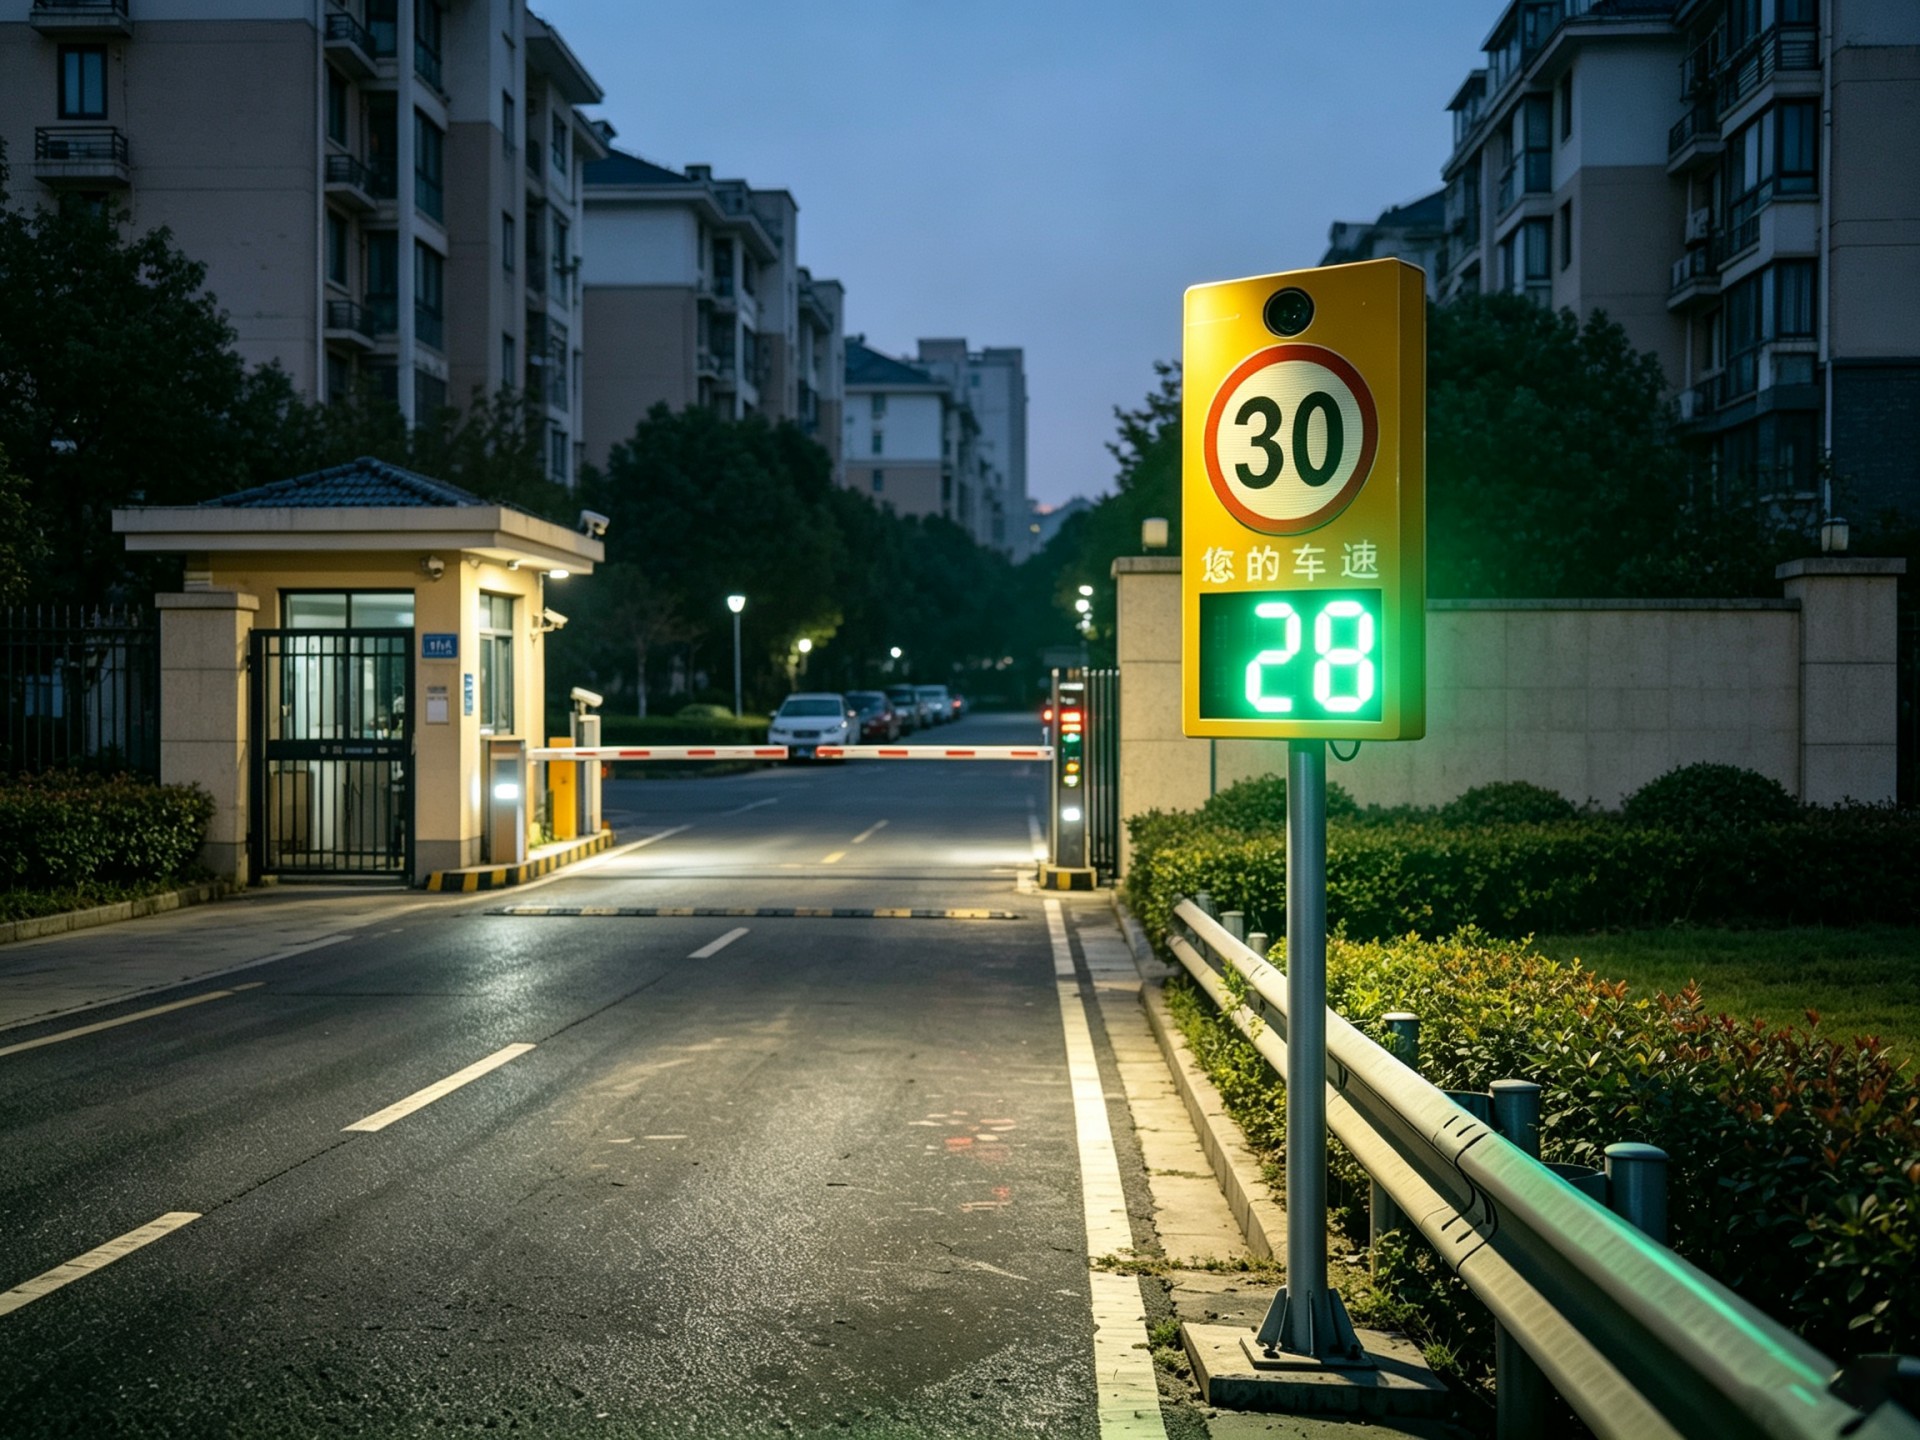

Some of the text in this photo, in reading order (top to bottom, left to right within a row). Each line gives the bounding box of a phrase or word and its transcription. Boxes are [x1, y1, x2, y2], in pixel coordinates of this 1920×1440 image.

[1235, 391, 1344, 489] 30
[1202, 540, 1379, 584] 您的车速
[1245, 601, 1375, 712] 28
